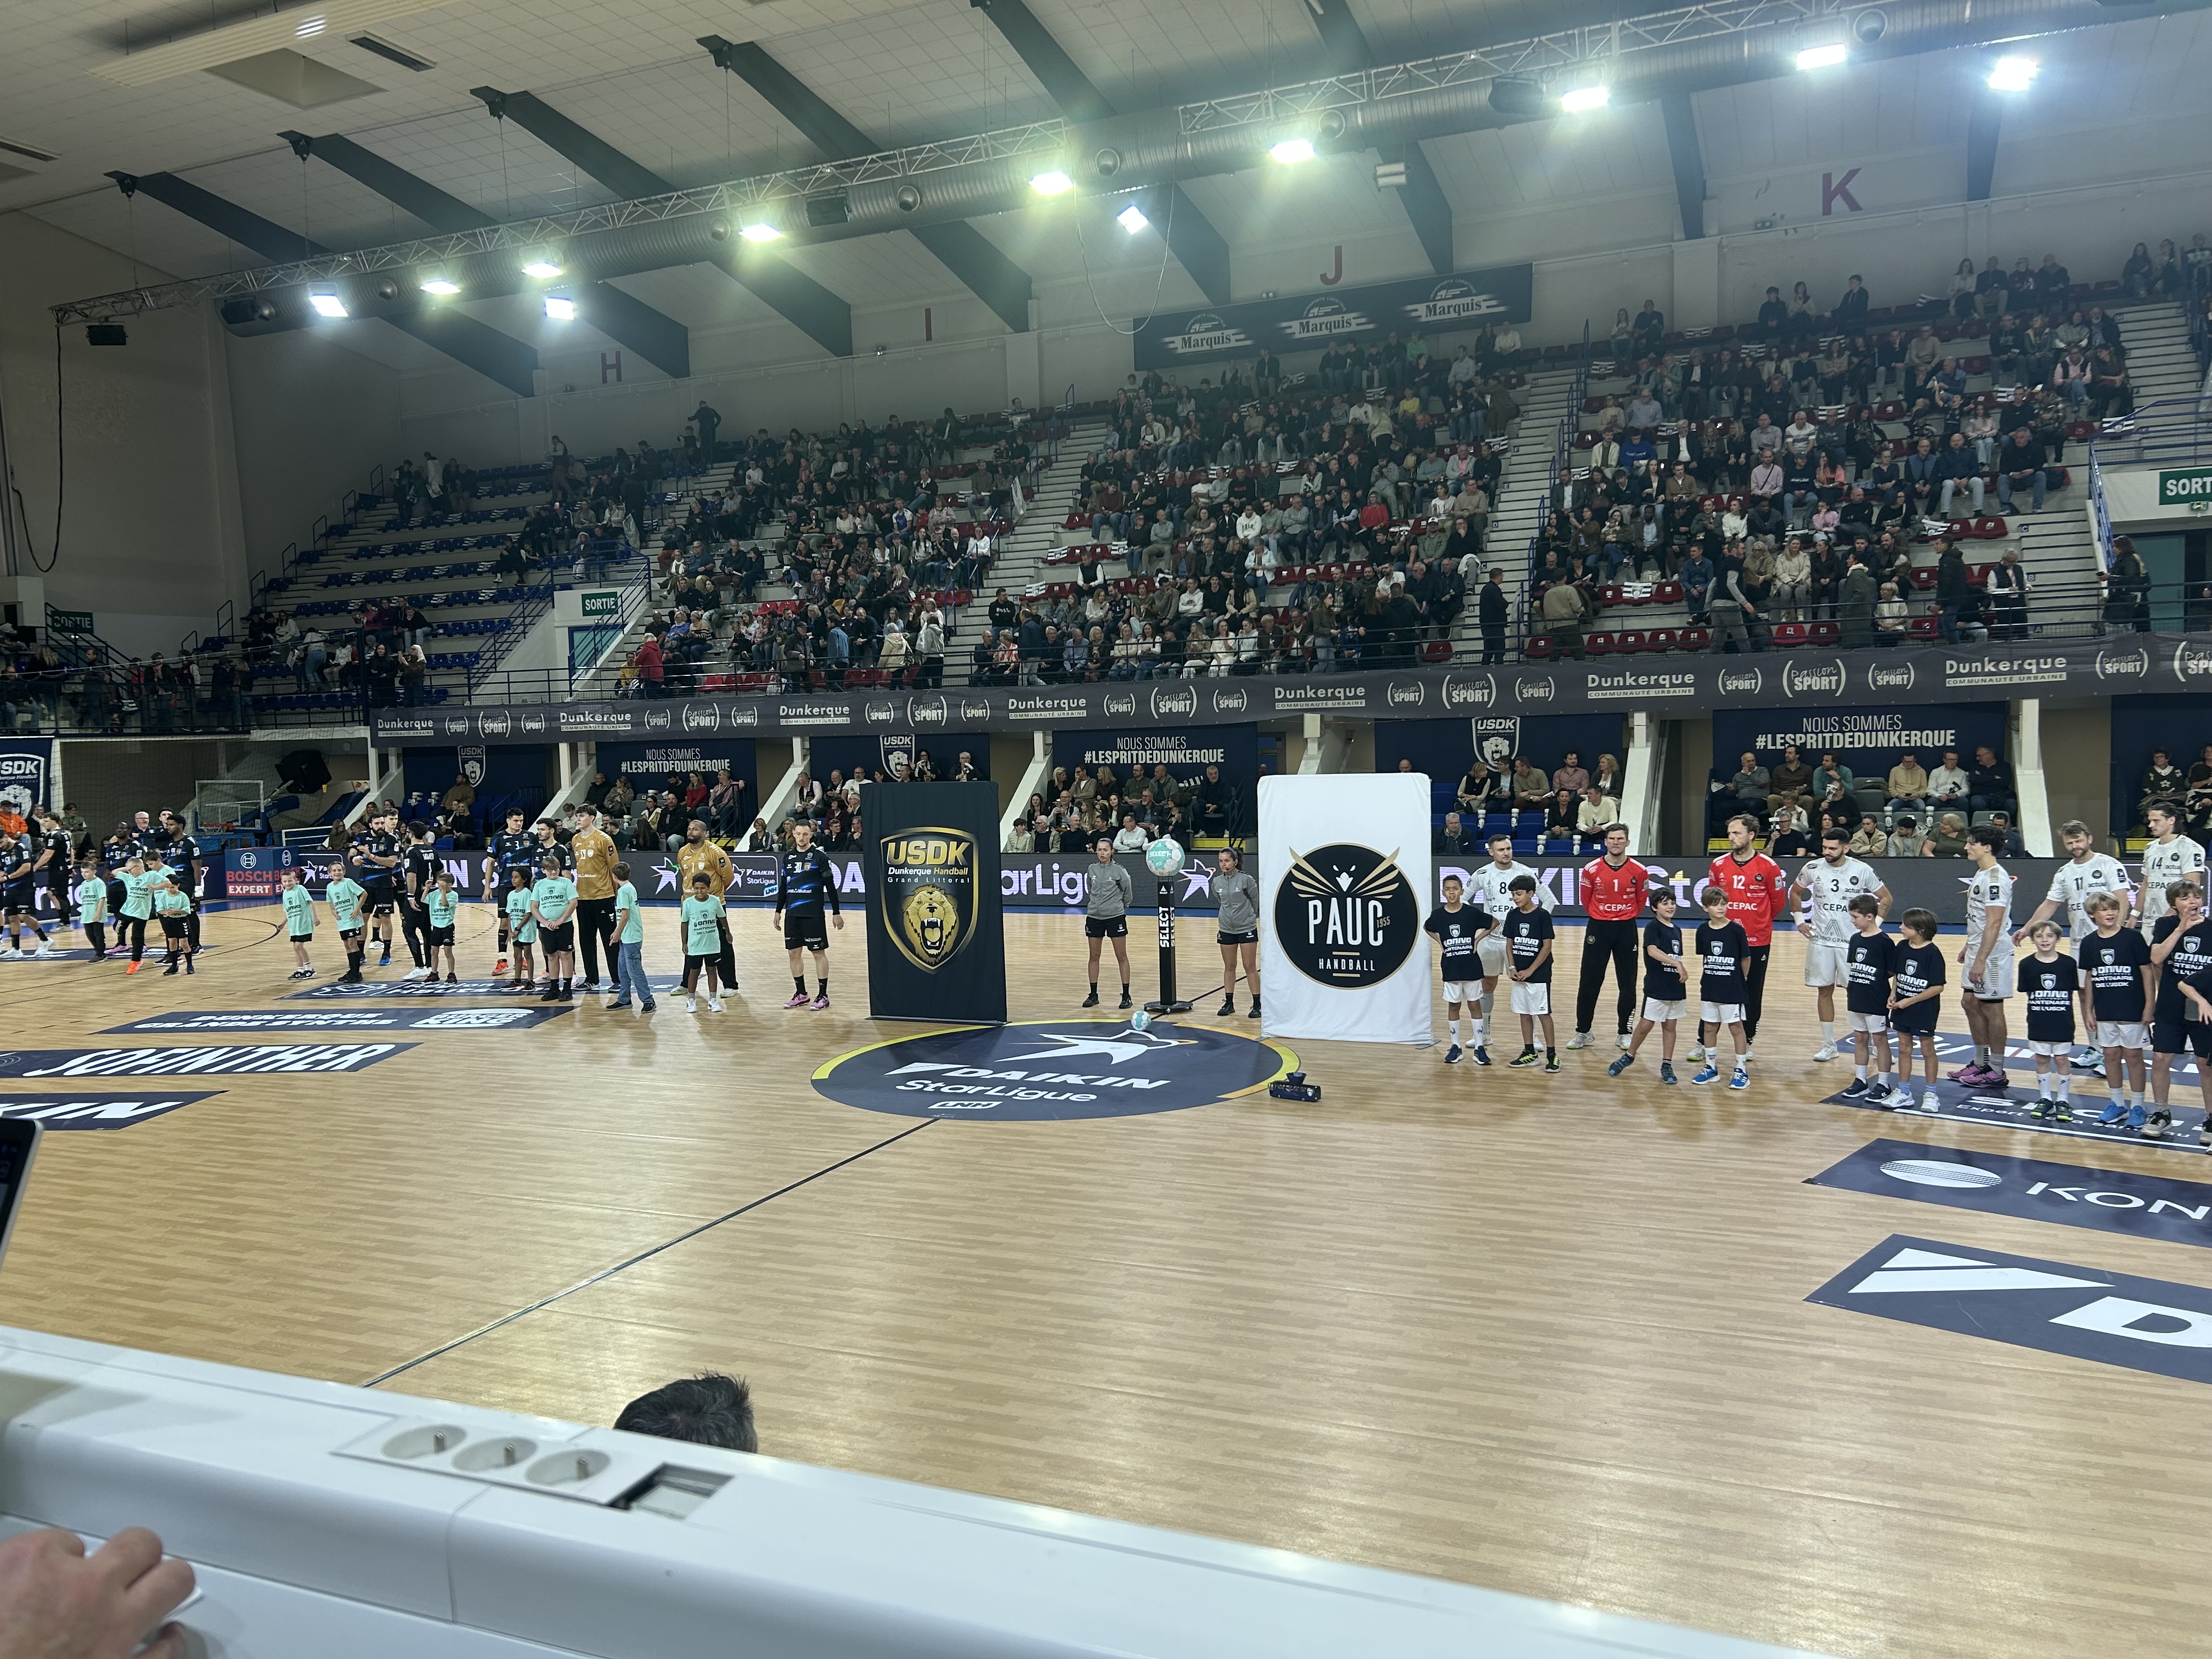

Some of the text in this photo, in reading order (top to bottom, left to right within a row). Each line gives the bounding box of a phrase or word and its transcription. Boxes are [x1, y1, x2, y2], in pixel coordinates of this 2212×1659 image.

[1822, 167, 1864, 216] K
[1319, 245, 1343, 286] J
[1425, 298, 1481, 317] Marquis
[1299, 316, 1352, 334] Marquis
[1181, 332, 1231, 349] Marquis
[601, 351, 622, 384] H
[585, 597, 616, 611] SORTIE
[1945, 656, 2067, 674] Dunkerque
[2105, 662, 2140, 674] SPORT
[1587, 672, 1695, 692] Dunkerque
[1726, 680, 1756, 691] SPORT
[1794, 675, 1838, 691] SPORT
[1877, 674, 1909, 686] SPORT
[1947, 676, 2013, 685] COMMUNAUTÉ
[1274, 685, 1365, 702] Dunkerque
[1394, 692, 1419, 702] SPORT
[1452, 689, 1489, 703] SPORT
[1522, 687, 1549, 698] SPORT
[1008, 697, 1086, 710] Dunkerque
[1109, 703, 1131, 713] SPORT
[1159, 700, 1192, 713] SPORT
[1219, 699, 1243, 708] SPORT
[560, 711, 631, 724] Dunkerque
[780, 704, 850, 719] Dunkerque
[870, 712, 890, 720] SPORT
[915, 709, 943, 721] SPORT
[966, 709, 986, 718] SPORT
[378, 718, 433, 731] Dunkerque
[526, 722, 542, 730] SPORT
[650, 718, 667, 726] SPORT
[689, 716, 715, 727] SPORT
[737, 715, 755, 724] SPORT
[1477, 719, 1516, 730] USDK
[1803, 714, 1901, 732] NOUS SOMMES
[450, 724, 466, 733] SPORT
[484, 723, 506, 733] SPORT
[884, 736, 912, 744] USDK
[1117, 736, 1186, 749] NOUS SOMMES
[1756, 730, 1955, 749] #LESPRITDEDUNKERQUE
[460, 747, 483, 755] USDK
[646, 748, 701, 760] NOUS SOMMES
[1085, 748, 1224, 764] #LESPRITDEDUNKERQUE
[0, 760, 39, 775] SDK
[887, 840, 970, 866] USDK
[2151, 857, 2164, 870] 14
[227, 871, 272, 882] BOSCH
[888, 867, 968, 876] Dunkerque Handball
[747, 877, 775, 885] StarLigue
[1613, 879, 1618, 892] 1
[1733, 875, 1746, 889] 12
[1831, 879, 1839, 893] 3
[2074, 876, 2083, 891] 11
[229, 885, 270, 894] EXPERT
[1499, 882, 1507, 894] 8
[1727, 901, 1758, 911] CEPAC
[1823, 903, 1848, 912] CEPA
[1159, 907, 1170, 947] SELECT
[1308, 898, 1384, 946] PAUC
[1376, 916, 1390, 928] 1955
[1319, 958, 1375, 972] HANDBALL
[190, 1013, 384, 1021] DUNKERQUE
[134, 1020, 269, 1029] GRANDE
[22, 1044, 397, 1077] SOFINTHER
[941, 1067, 1171, 1089] DAIKIN
[895, 1079, 1098, 1101] StarLigue
